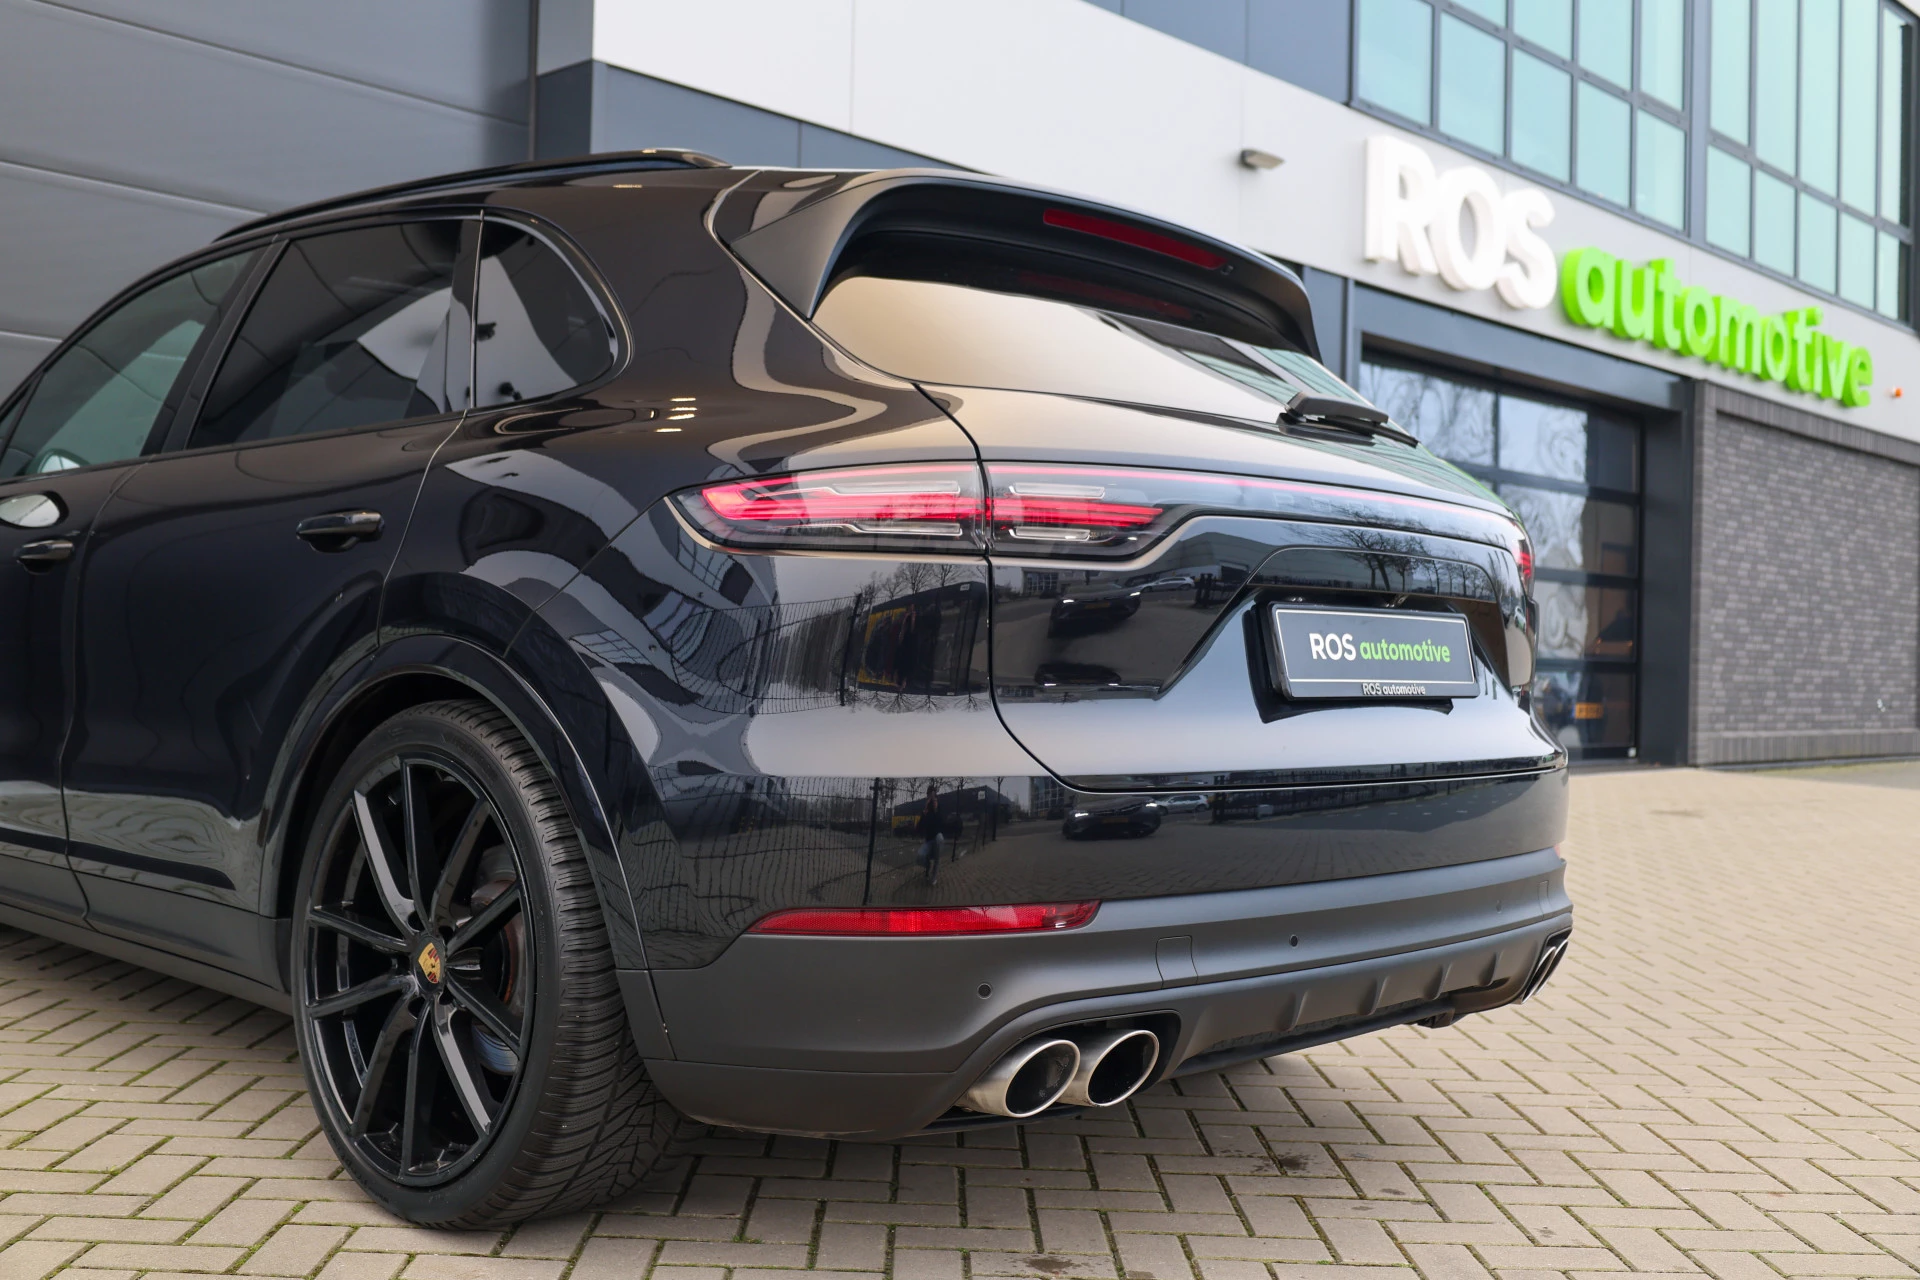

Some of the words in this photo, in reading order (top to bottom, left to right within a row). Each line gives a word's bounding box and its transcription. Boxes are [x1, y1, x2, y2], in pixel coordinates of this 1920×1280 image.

[1365, 135, 1557, 309] ROS
[1560, 247, 1873, 407] automotive
[1309, 633, 1357, 661] ROS
[1360, 639, 1451, 663] automotive
[1362, 683, 1382, 696] ROS
[1383, 684, 1426, 695] automotive
